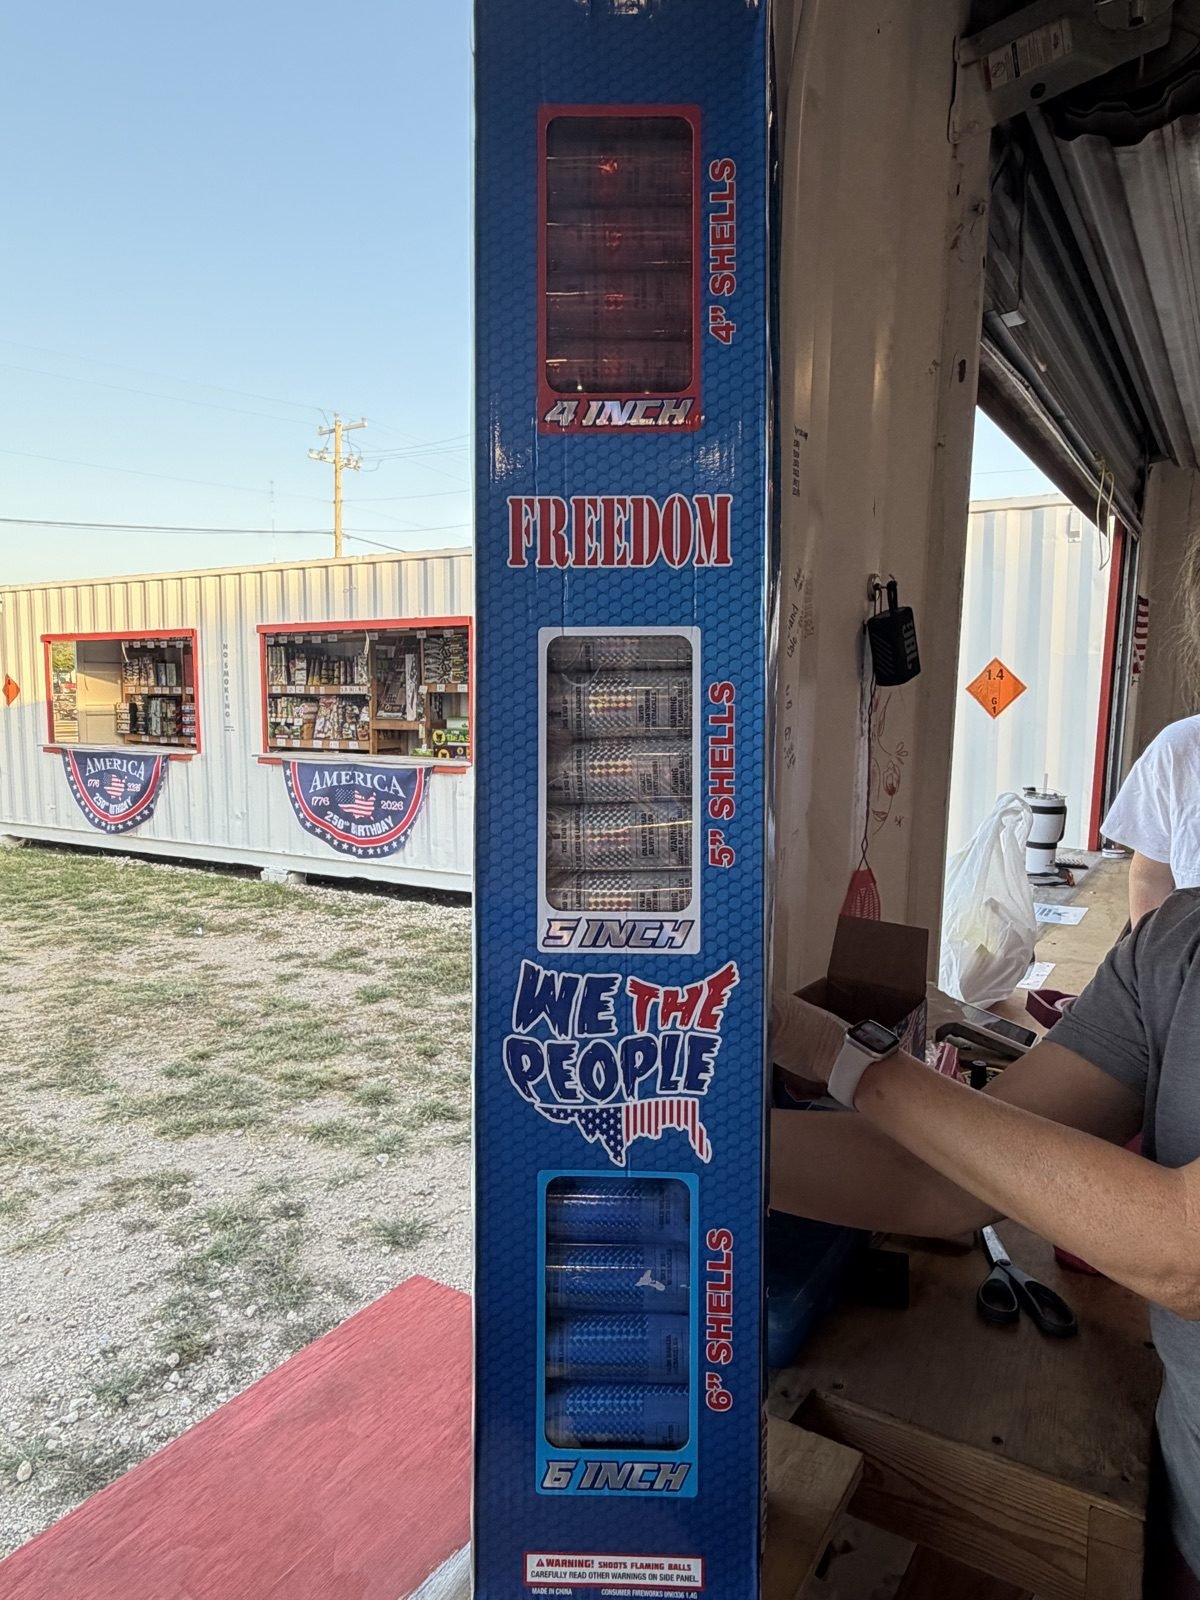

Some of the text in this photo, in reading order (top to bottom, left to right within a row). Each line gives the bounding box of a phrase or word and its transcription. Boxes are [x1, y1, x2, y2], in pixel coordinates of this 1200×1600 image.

[710, 158, 736, 297] SHELLS
[545, 399, 695, 427] 4 INCH
[506, 494, 733, 569] FREEDOM
[986, 669, 1004, 680] 1.4
[223, 662, 231, 718] SMOKING
[991, 697, 997, 705] G
[86, 757, 144, 781] AMERICA
[708, 680, 736, 868] 5" SHELLS
[88, 779, 100, 788] 1776
[309, 770, 406, 798] AMERICA
[311, 796, 330, 806] 1776
[381, 800, 404, 811] 2026
[351, 815, 394, 837] BIRTHDAY
[543, 917, 695, 948] 5 INCH
[512, 959, 740, 1039] WE THE
[503, 1032, 722, 1104] PEOPLE
[705, 1228, 734, 1412] 6" SHELLS
[541, 1460, 692, 1491] 6 INCH
[531, 1570, 567, 1579] CAREFULLY
[569, 1571, 587, 1579] READ
[588, 1571, 610, 1580] OTHER
[611, 1572, 647, 1581] WARNINGS
[648, 1573, 657, 1581] ON
[659, 1573, 674, 1581] SIDE
[546, 1558, 691, 1571] WARNING! SHOOTS FLAMING BALLS
[632, 1589, 663, 1598] FIREWORKS
